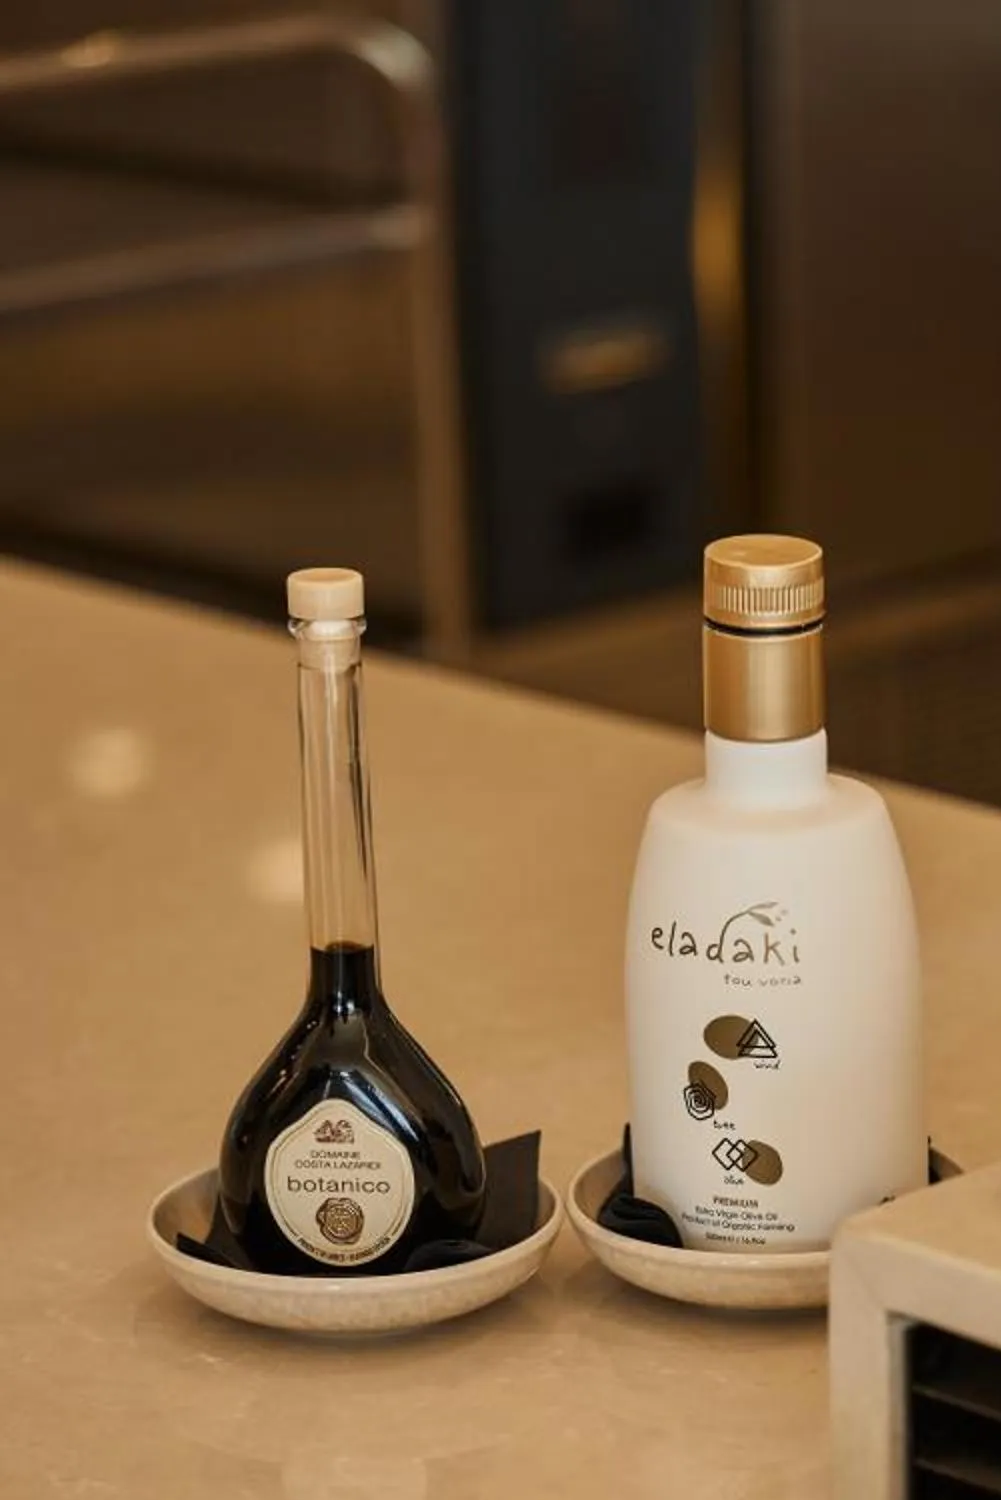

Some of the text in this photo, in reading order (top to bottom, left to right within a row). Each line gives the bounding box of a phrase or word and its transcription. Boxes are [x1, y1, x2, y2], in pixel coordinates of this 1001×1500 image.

[651, 906, 800, 966] eladaki
[311, 1150, 361, 1159] DOMAINE
[287, 1176, 391, 1194] botanico
[713, 1196, 759, 1209] PREMIUM
[740, 1211, 763, 1221] Olive
[721, 1219, 757, 1231] Organic
